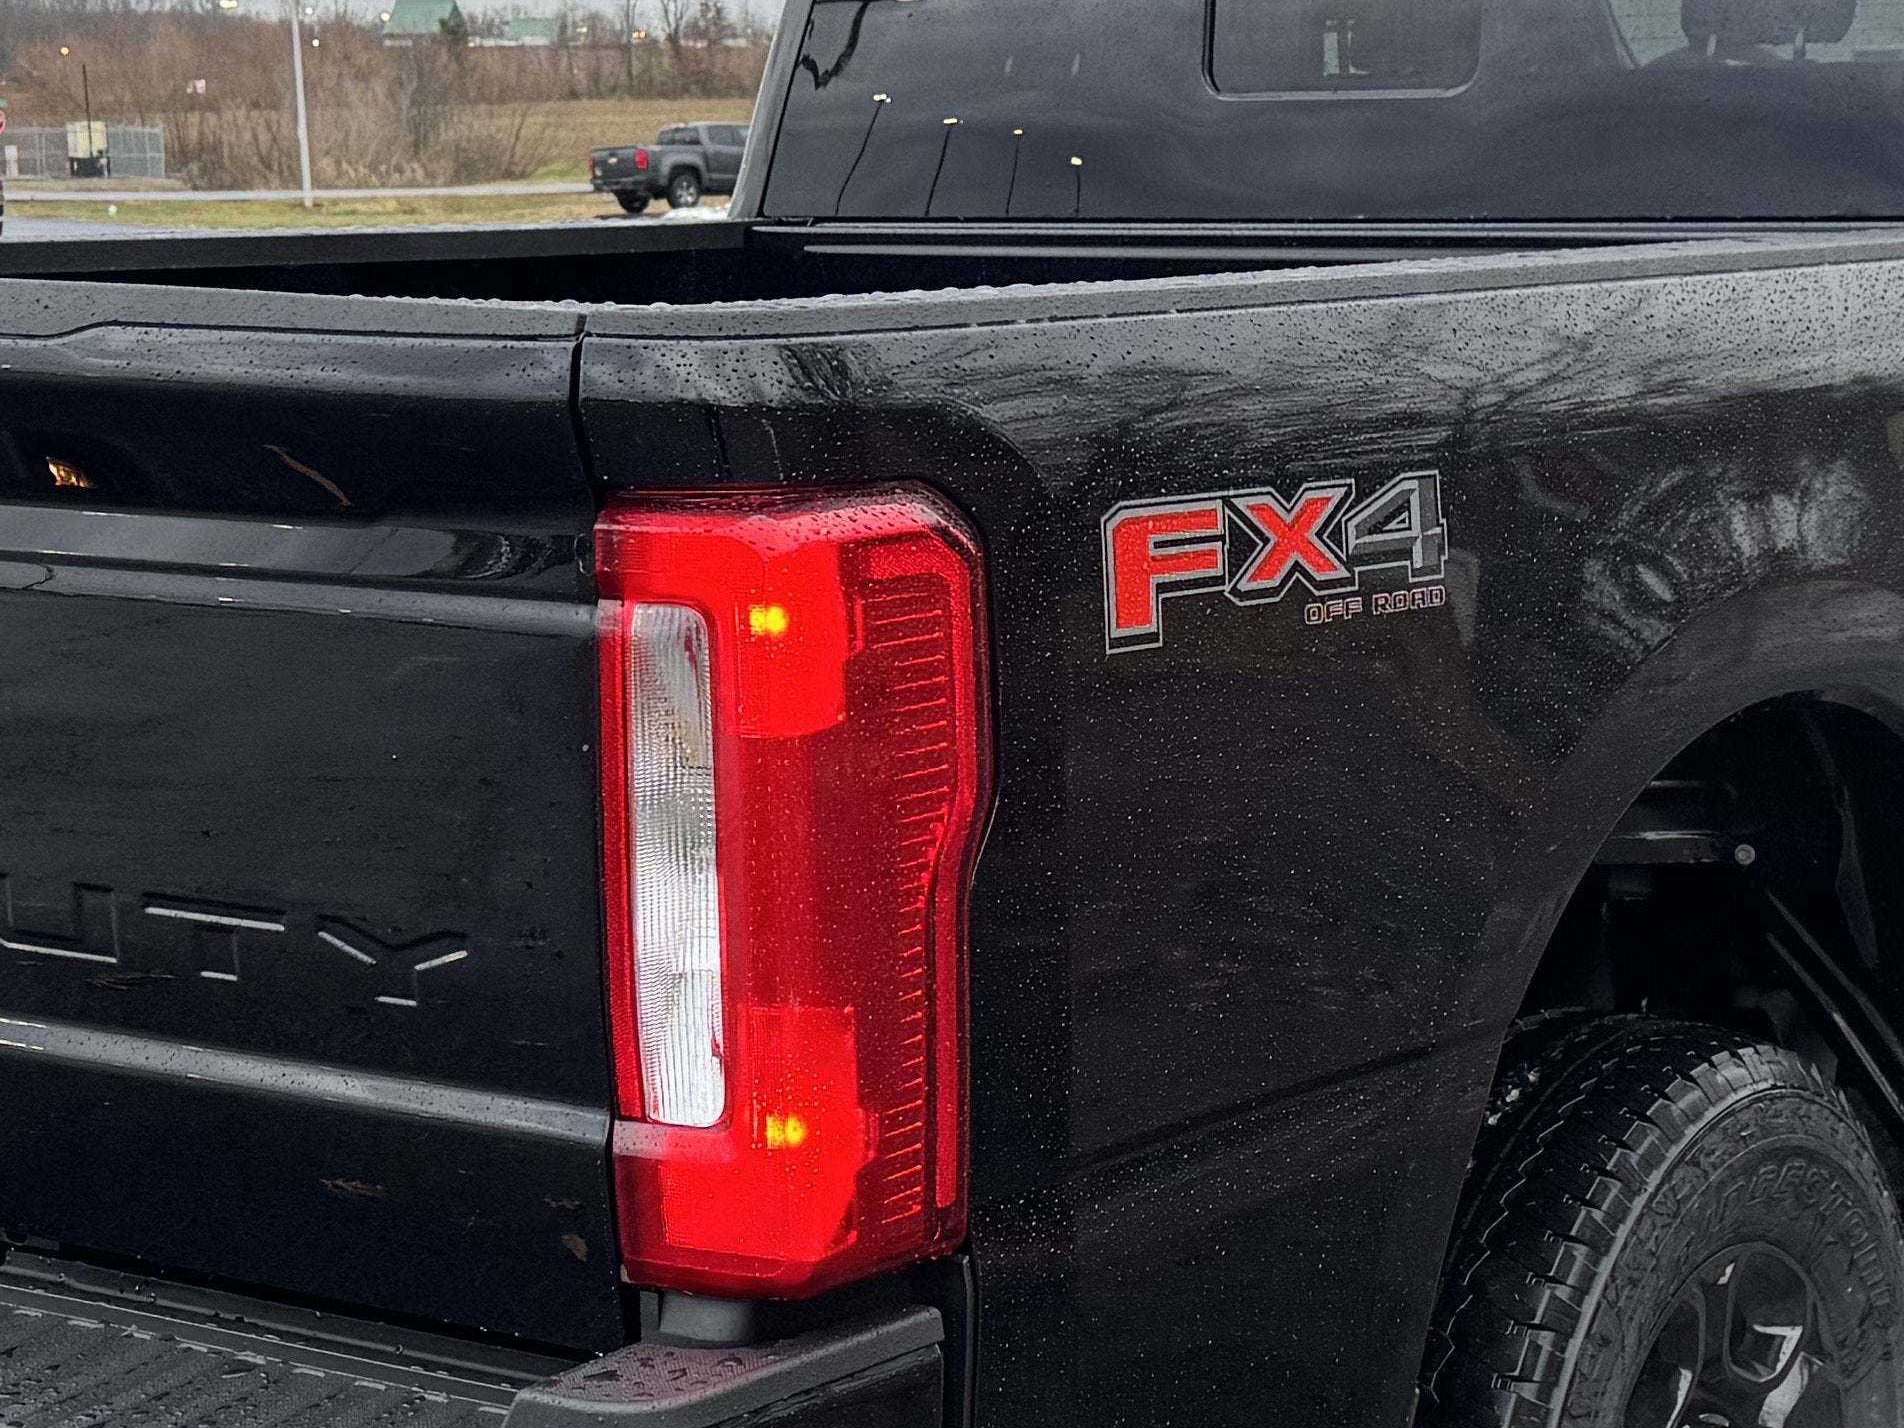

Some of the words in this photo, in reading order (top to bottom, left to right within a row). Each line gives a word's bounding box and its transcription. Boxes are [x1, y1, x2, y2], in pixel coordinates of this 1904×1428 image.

[1100, 470, 1448, 655] FX4
[1304, 596, 1362, 625] OFF
[1372, 585, 1446, 615] ROAD
